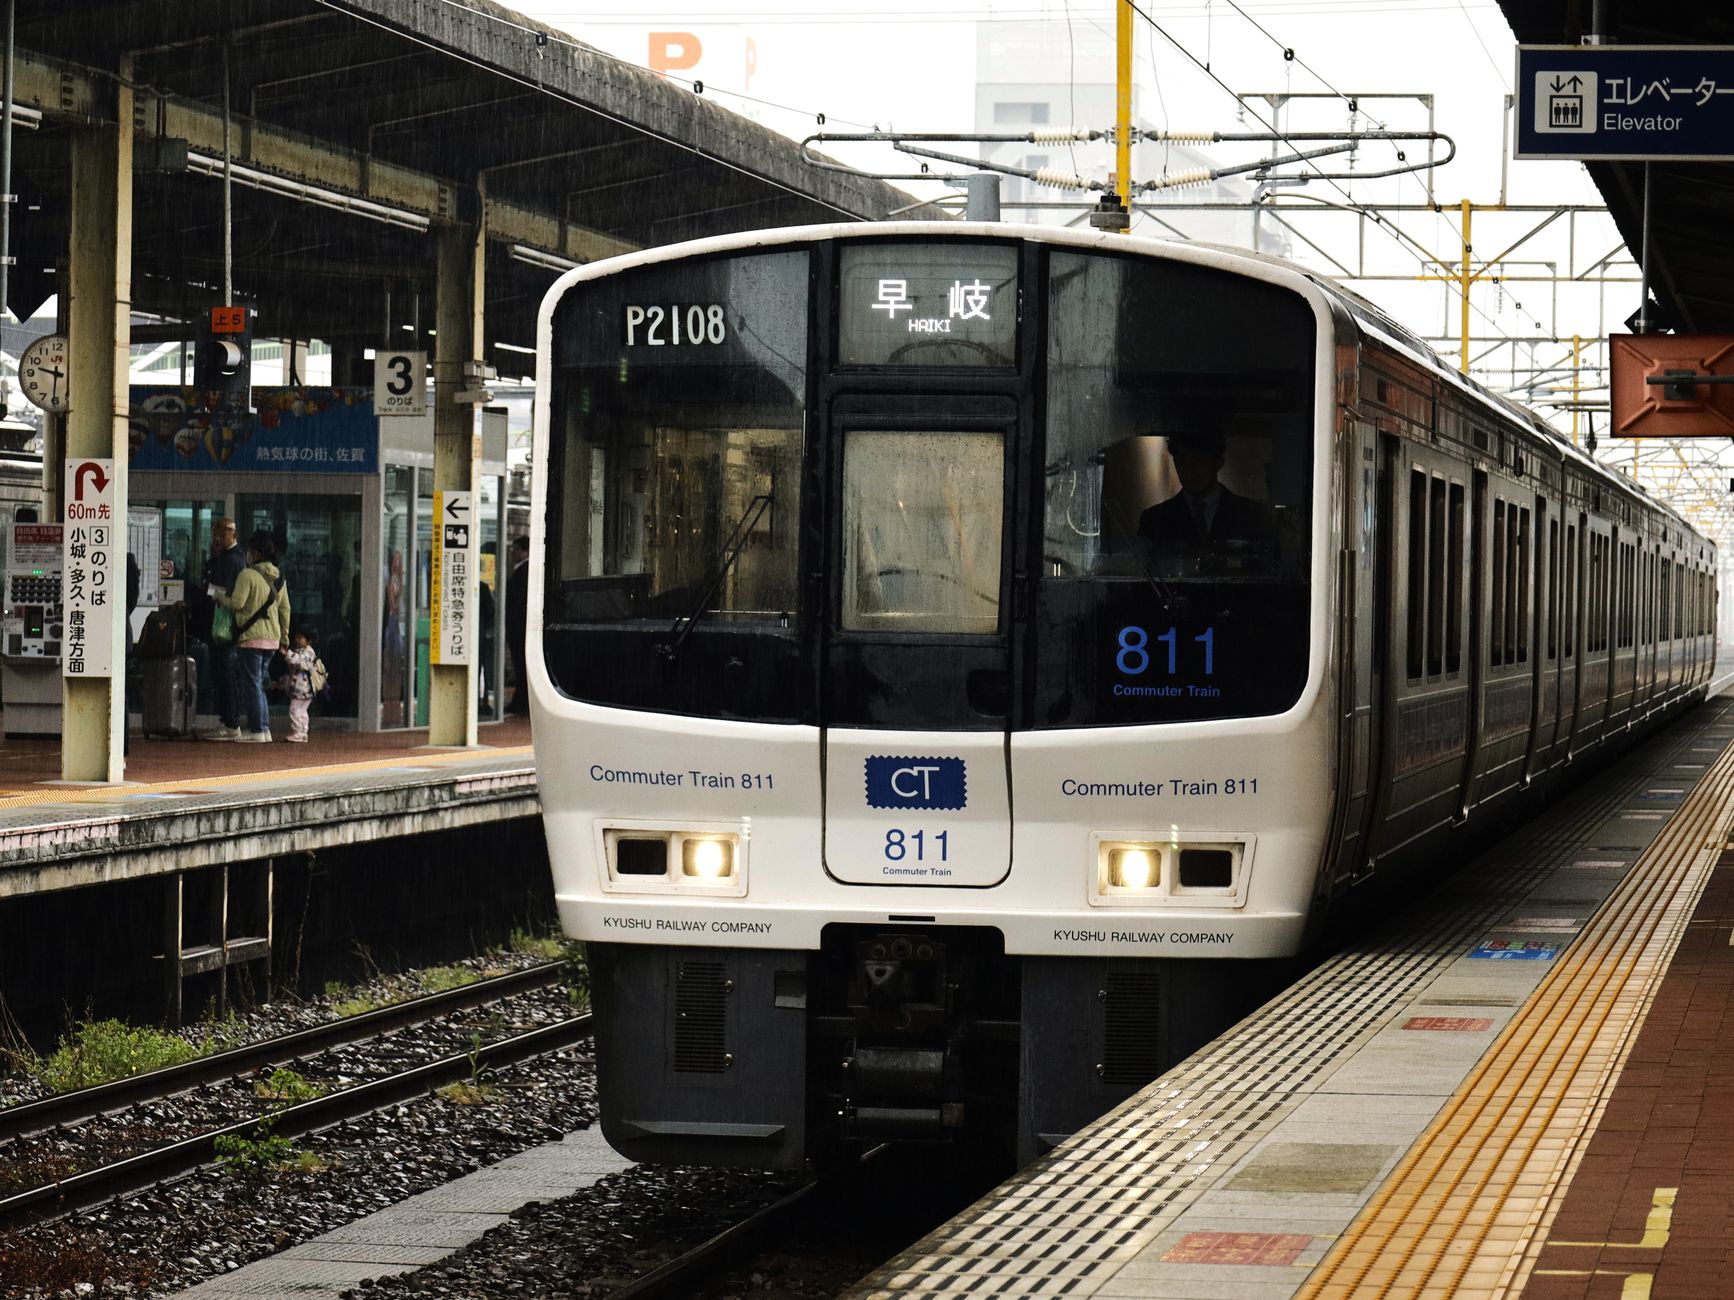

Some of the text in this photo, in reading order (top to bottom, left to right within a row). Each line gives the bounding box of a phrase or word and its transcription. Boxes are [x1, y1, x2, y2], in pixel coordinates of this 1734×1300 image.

[648, 32, 702, 80] P
[1603, 76, 1734, 106] エレベーター
[1603, 113, 1682, 131] Elevator
[626, 304, 726, 346] P2108
[908, 318, 951, 333] HAIKI
[39, 347, 49, 356] 11
[52, 342, 63, 352] 12
[30, 357, 42, 366] 10
[26, 368, 35, 378] 9
[386, 355, 413, 396] 3
[29, 381, 38, 390] 8
[39, 392, 48, 401] 7
[387, 396, 414, 406] のりば
[255, 446, 366, 462] 熱気球の街、佐賀
[69, 527, 86, 674] 小城・多久・唐津方面
[451, 551, 466, 656] 自由席特急券うりば
[1116, 625, 1214, 675] 811
[1113, 683, 1221, 697] Commuter Train
[590, 765, 774, 789] Commuter Train 811
[890, 766, 940, 800] CT
[1061, 778, 1258, 796] Commuter Train 811
[884, 828, 948, 862] 811
[882, 866, 952, 877] Commuter Train
[603, 917, 772, 933] KYUSHU RAILWAY COMPANY
[1053, 930, 1235, 944] KYUSHU RAILWAY COMPANY
